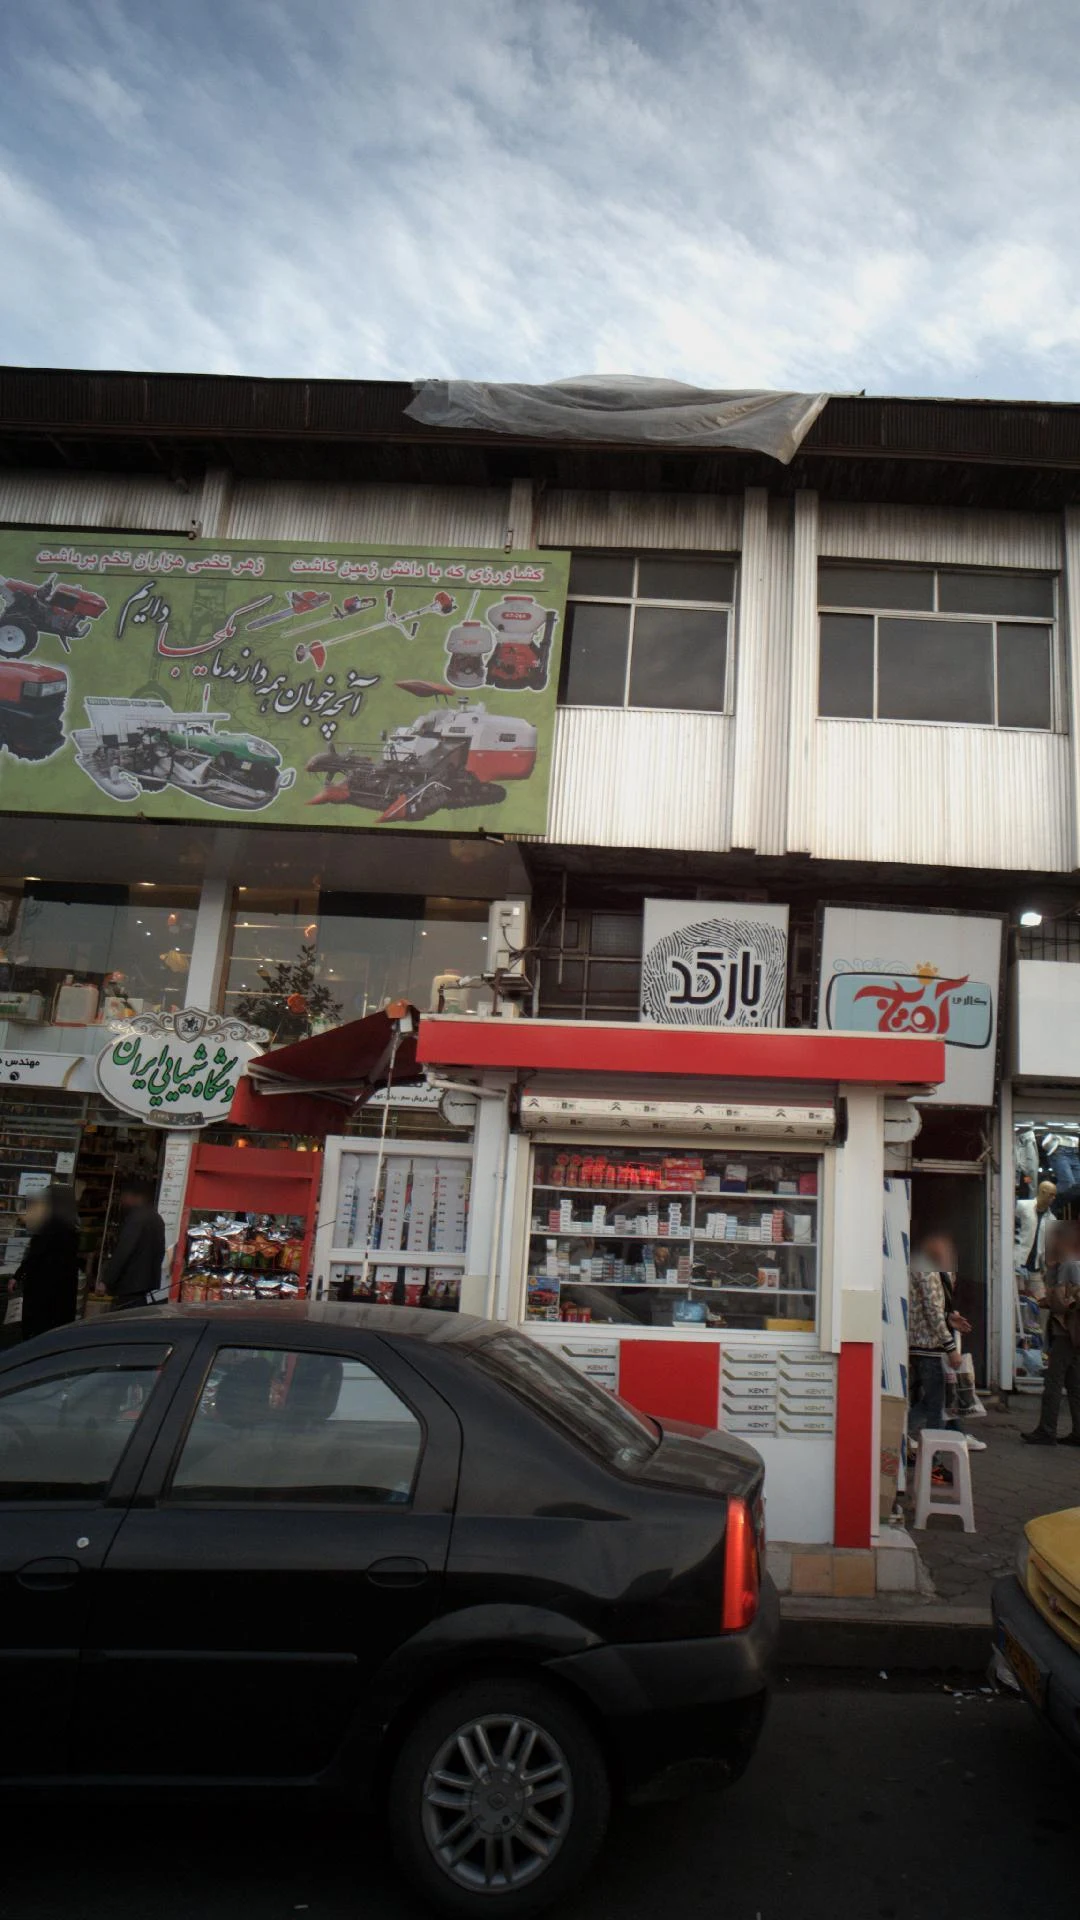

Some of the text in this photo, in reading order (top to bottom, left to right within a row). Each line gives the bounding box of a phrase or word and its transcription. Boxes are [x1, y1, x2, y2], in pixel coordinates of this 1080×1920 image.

[37, 548, 544, 584] کشاورزی که با دانش زمین کاشت زهر تخمی هزاران تخم برداشت
[117, 580, 171, 639] داریم
[255, 675, 287, 711] همه
[274, 675, 335, 726] خوبان
[320, 671, 380, 740] آنچه
[669, 950, 762, 1021] بارکد
[5, 1057, 41, 1069] مهندس
[112, 1036, 170, 1090] ایران
[191, 1046, 239, 1103] وشگاه
